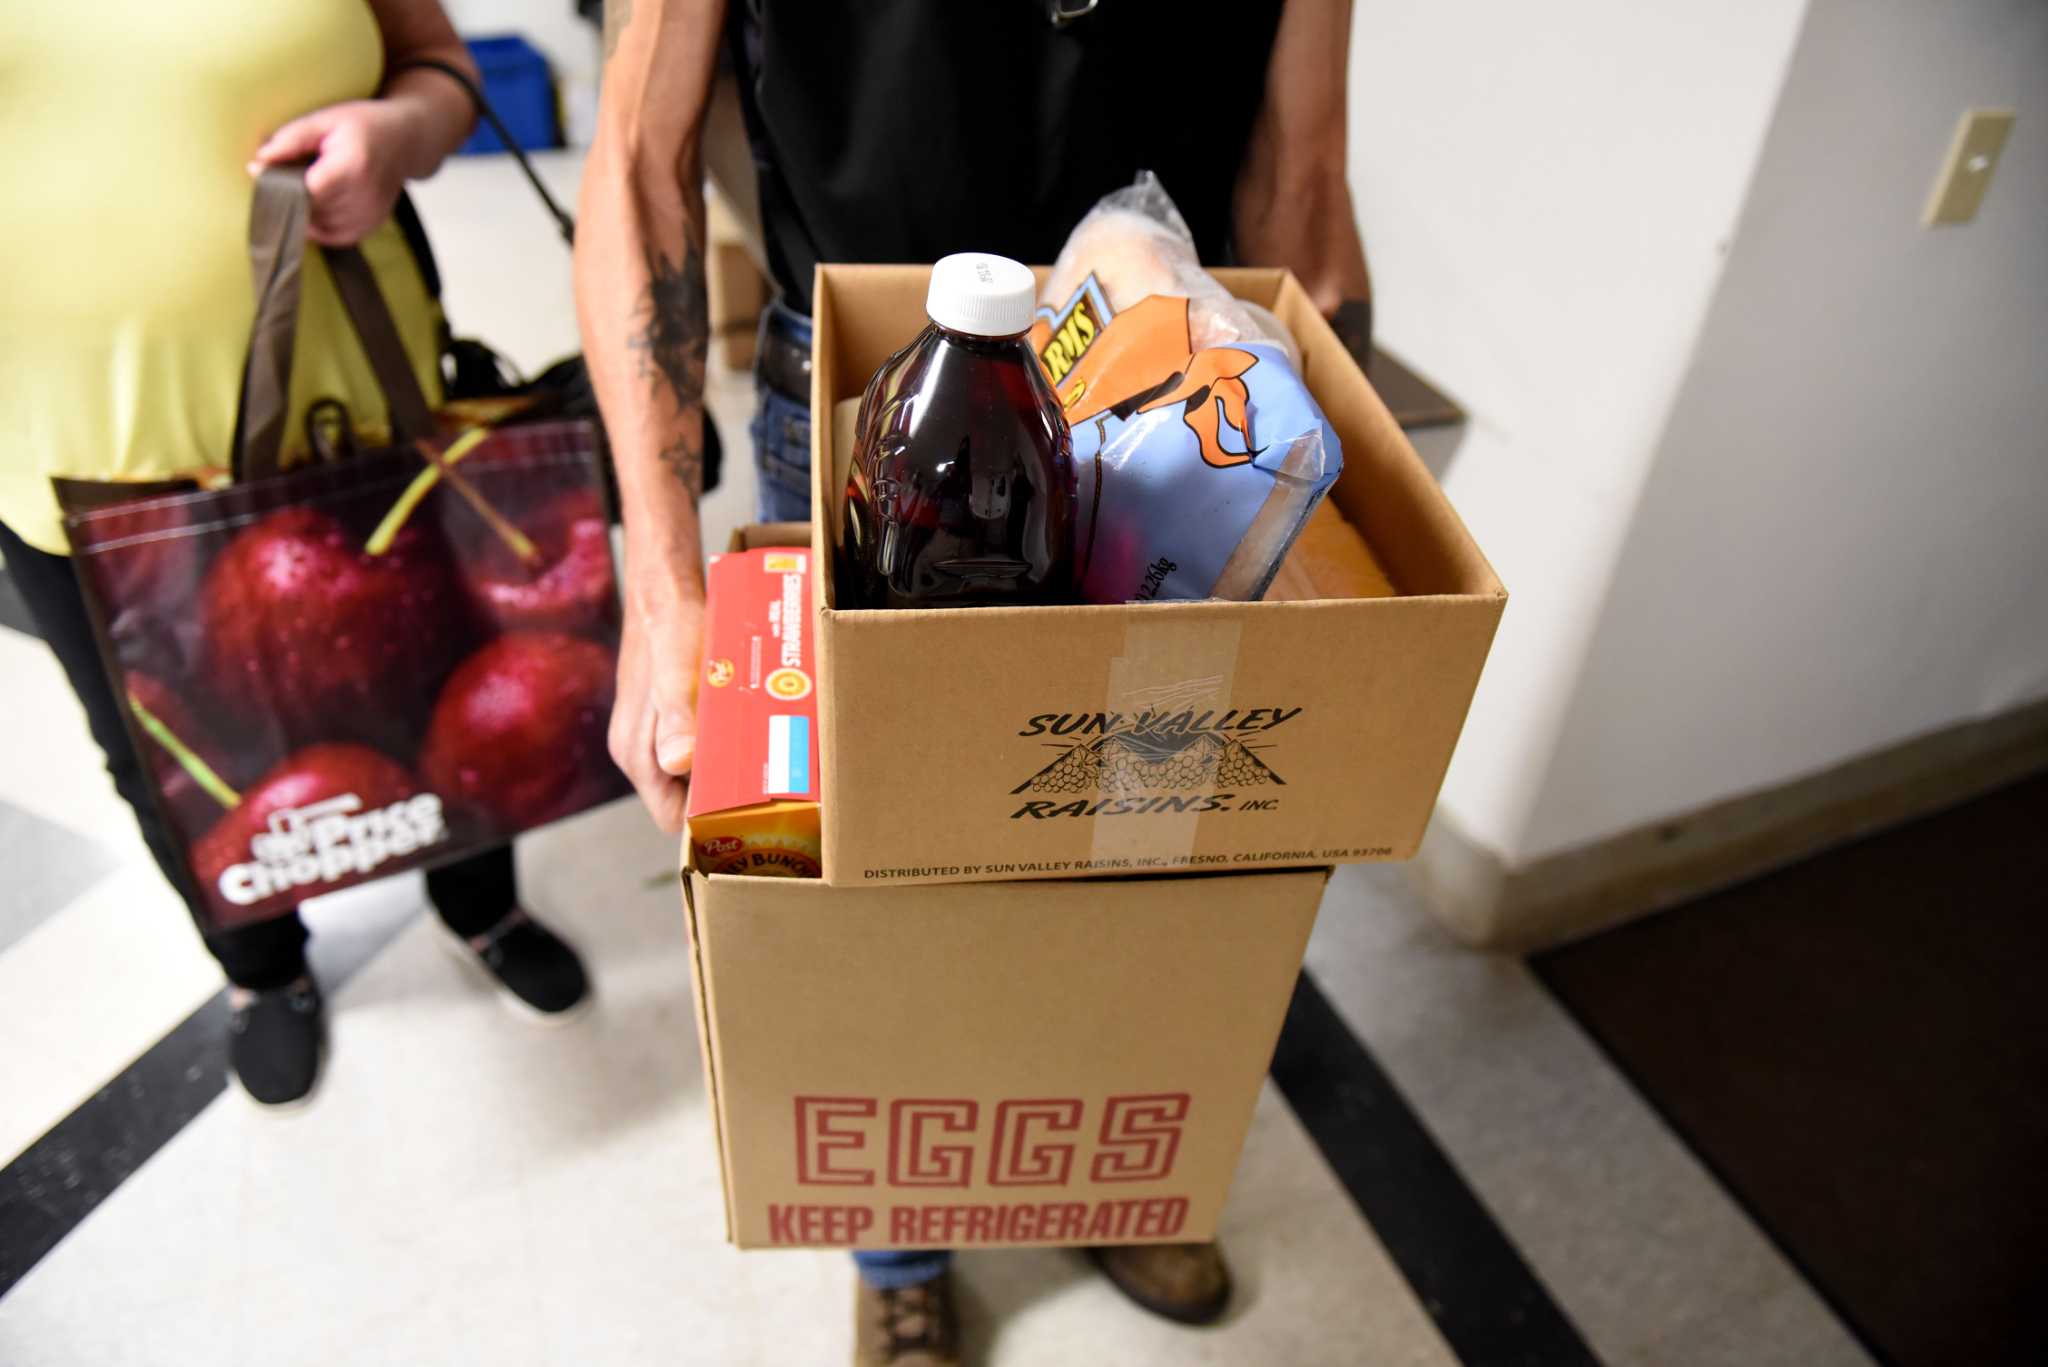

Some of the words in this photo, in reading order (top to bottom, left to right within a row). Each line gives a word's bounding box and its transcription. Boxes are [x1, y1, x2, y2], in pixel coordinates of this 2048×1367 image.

[1044, 302, 1095, 385] RMS
[1018, 711, 1121, 737] SUN
[1131, 707, 1302, 735] VALLEY
[704, 836, 739, 854] Post
[751, 853, 812, 876] BUNC
[864, 866, 959, 879] DISTRIBUTED
[964, 865, 981, 874] BY
[986, 863, 1016, 874] SUN
[1019, 861, 1071, 872] VALLEY
[1322, 848, 1348, 858] USA
[794, 1093, 1191, 1188] EGGS
[767, 1203, 874, 1244] KEEP
[889, 1197, 1190, 1244] REFRIGERATED
